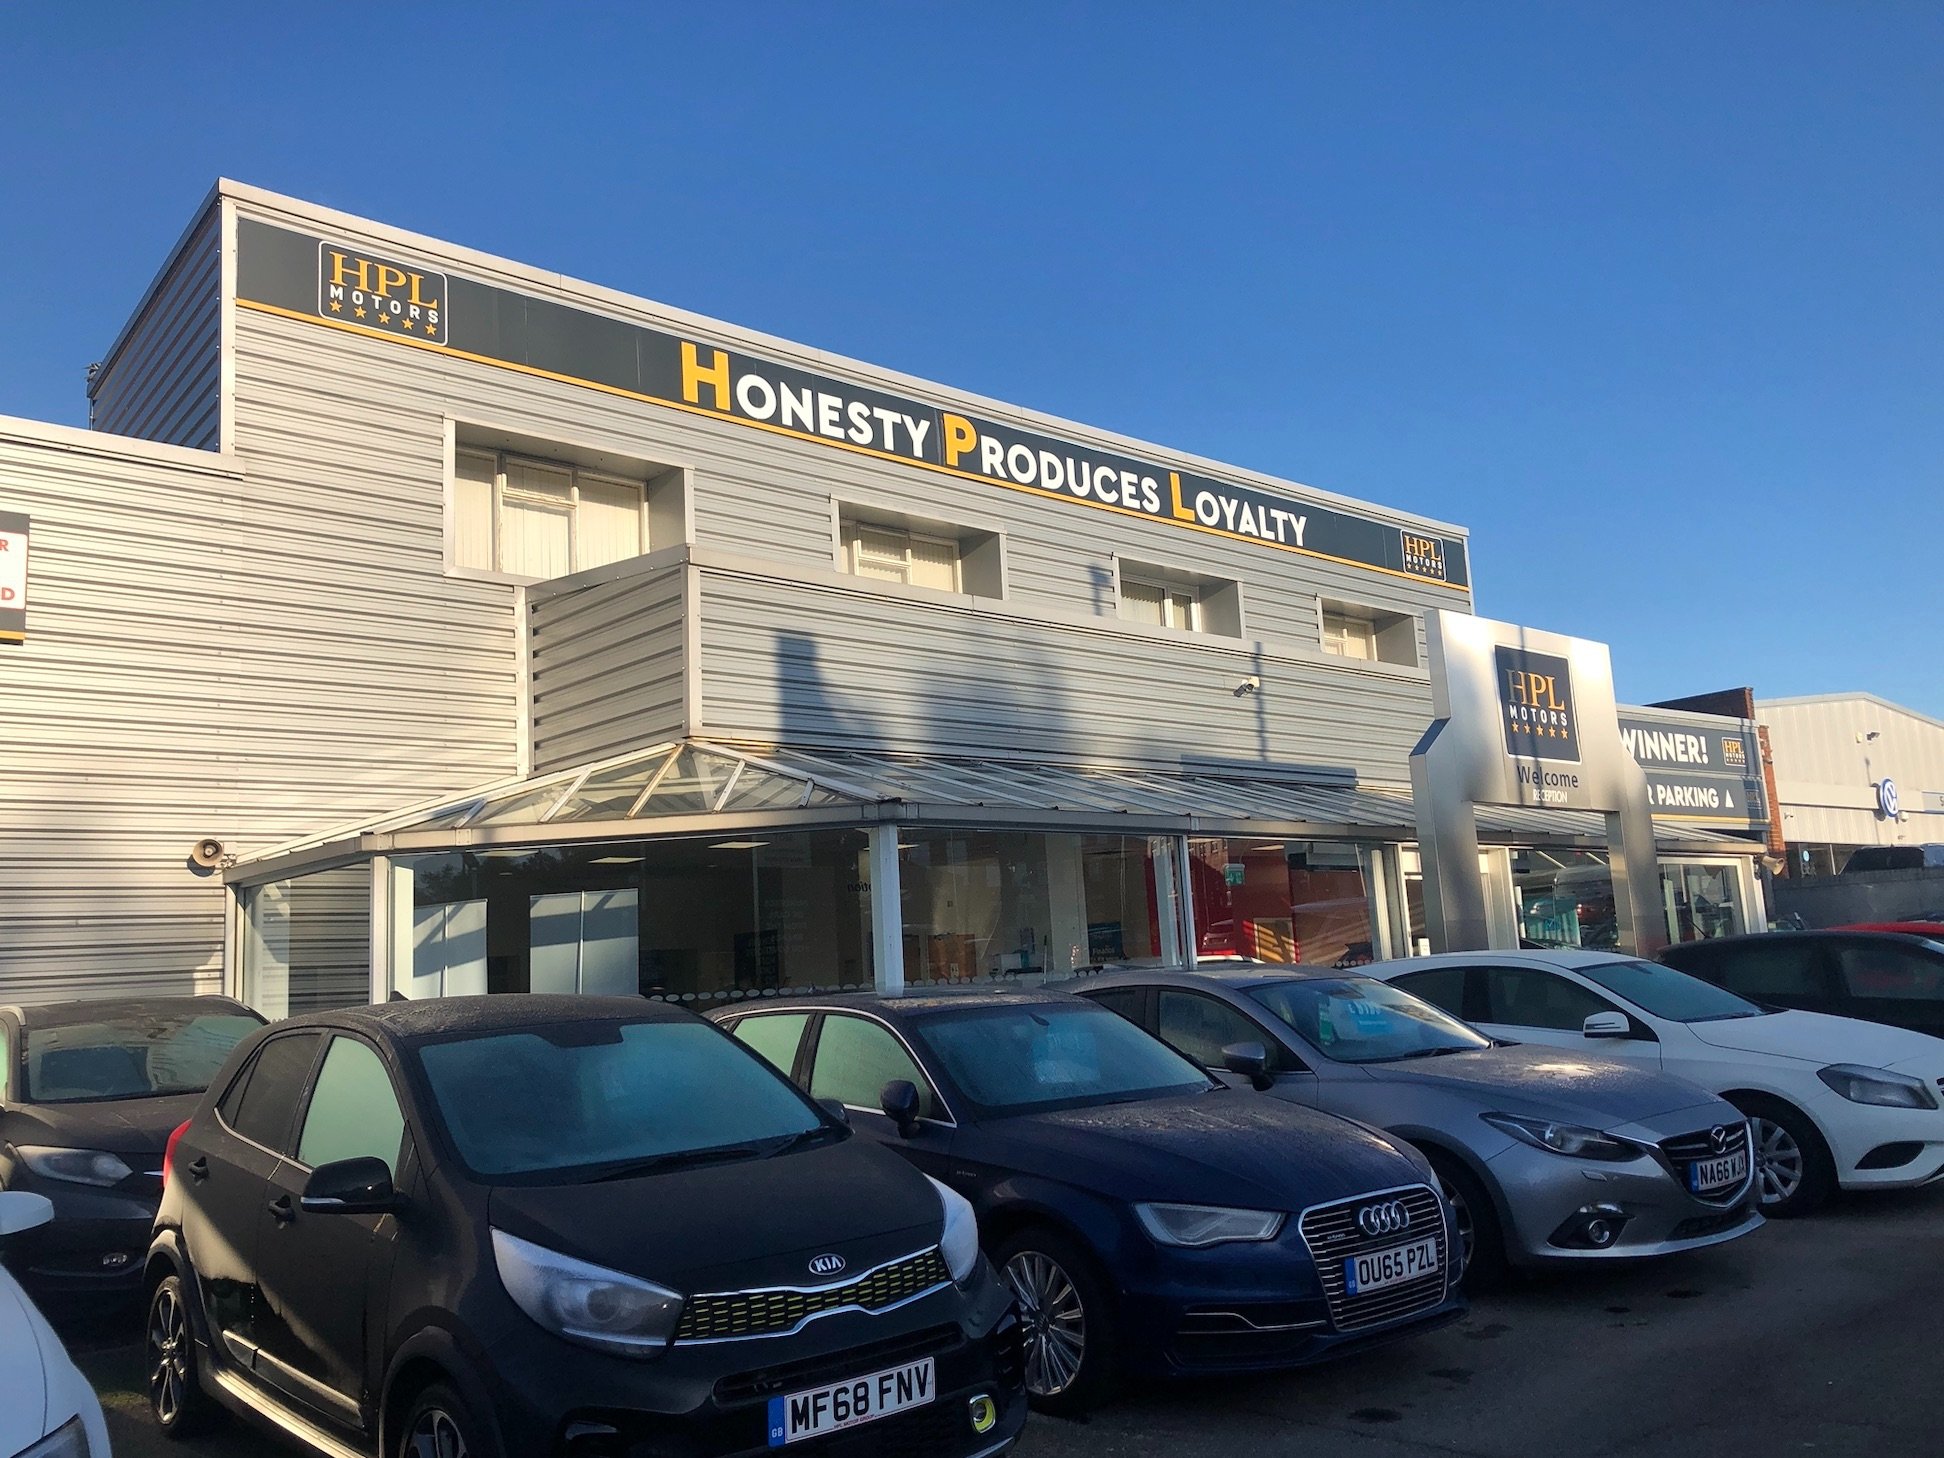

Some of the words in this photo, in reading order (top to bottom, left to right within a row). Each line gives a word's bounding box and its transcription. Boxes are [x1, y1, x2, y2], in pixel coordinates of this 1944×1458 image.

[329, 251, 438, 309] HPL
[330, 284, 439, 324] MOTORS
[680, 341, 931, 458] HONESTY
[943, 412, 1161, 514] PRODUCES
[1169, 472, 1308, 546] LOYALTY
[1404, 535, 1442, 560] HPL
[1405, 554, 1443, 569] MOTORS
[1505, 669, 1566, 711] HPL
[1509, 704, 1568, 727] MOTORS
[1620, 728, 1709, 764] WINNER!
[1517, 765, 1579, 788] Welcome
[1532, 788, 1568, 803] RECEPTION
[1657, 784, 1719, 808] PARKING
[1700, 1160, 1729, 1186] NA66
[813, 1255, 841, 1272] KIA
[1359, 1254, 1404, 1285] OU65
[1407, 1243, 1435, 1274] PZL
[790, 1381, 870, 1434] MF68
[878, 1363, 929, 1410] FNV
[771, 1426, 784, 1439] GB
